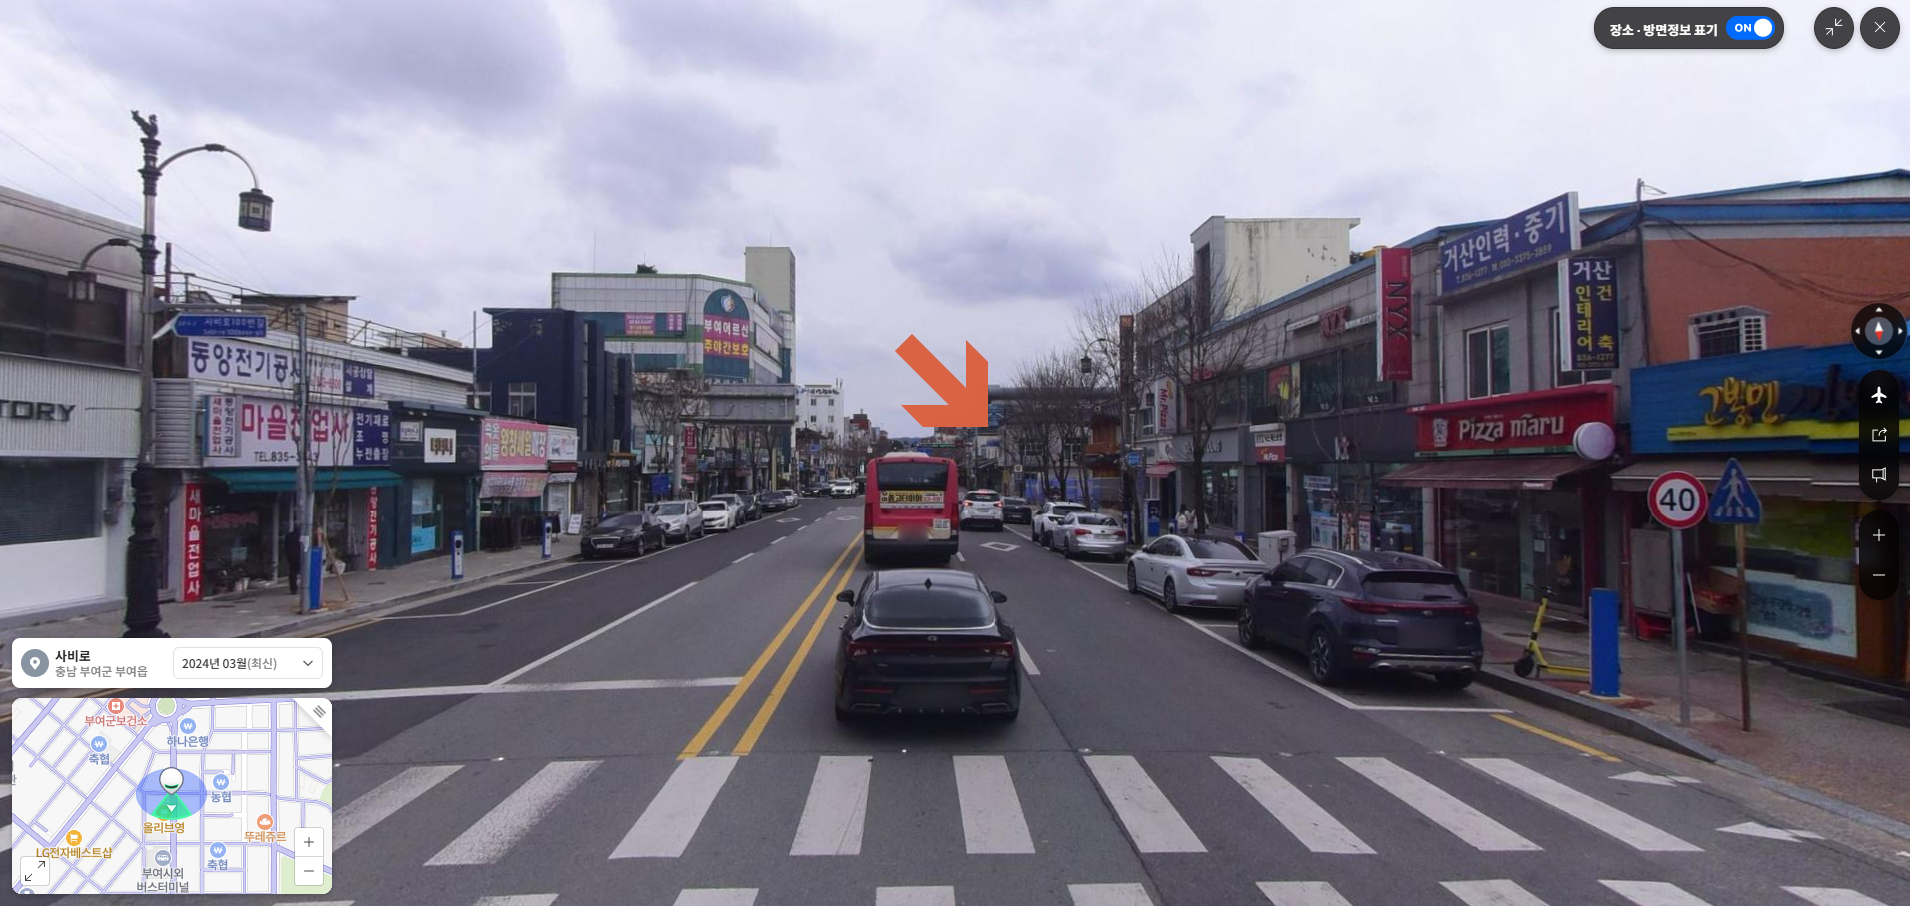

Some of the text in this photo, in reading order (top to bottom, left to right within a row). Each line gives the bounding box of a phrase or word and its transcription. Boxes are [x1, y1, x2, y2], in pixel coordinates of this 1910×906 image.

[1573, 260, 1613, 281] 거산
[1385, 280, 1408, 341] NYX
[1575, 285, 1593, 352] 인테리어
[704, 319, 749, 338] 부여어르신
[704, 339, 749, 357] 주야간보호
[1459, 416, 1505, 442] Pizza
[1660, 488, 1695, 511] 40
[187, 488, 202, 595] 새마을전업사
